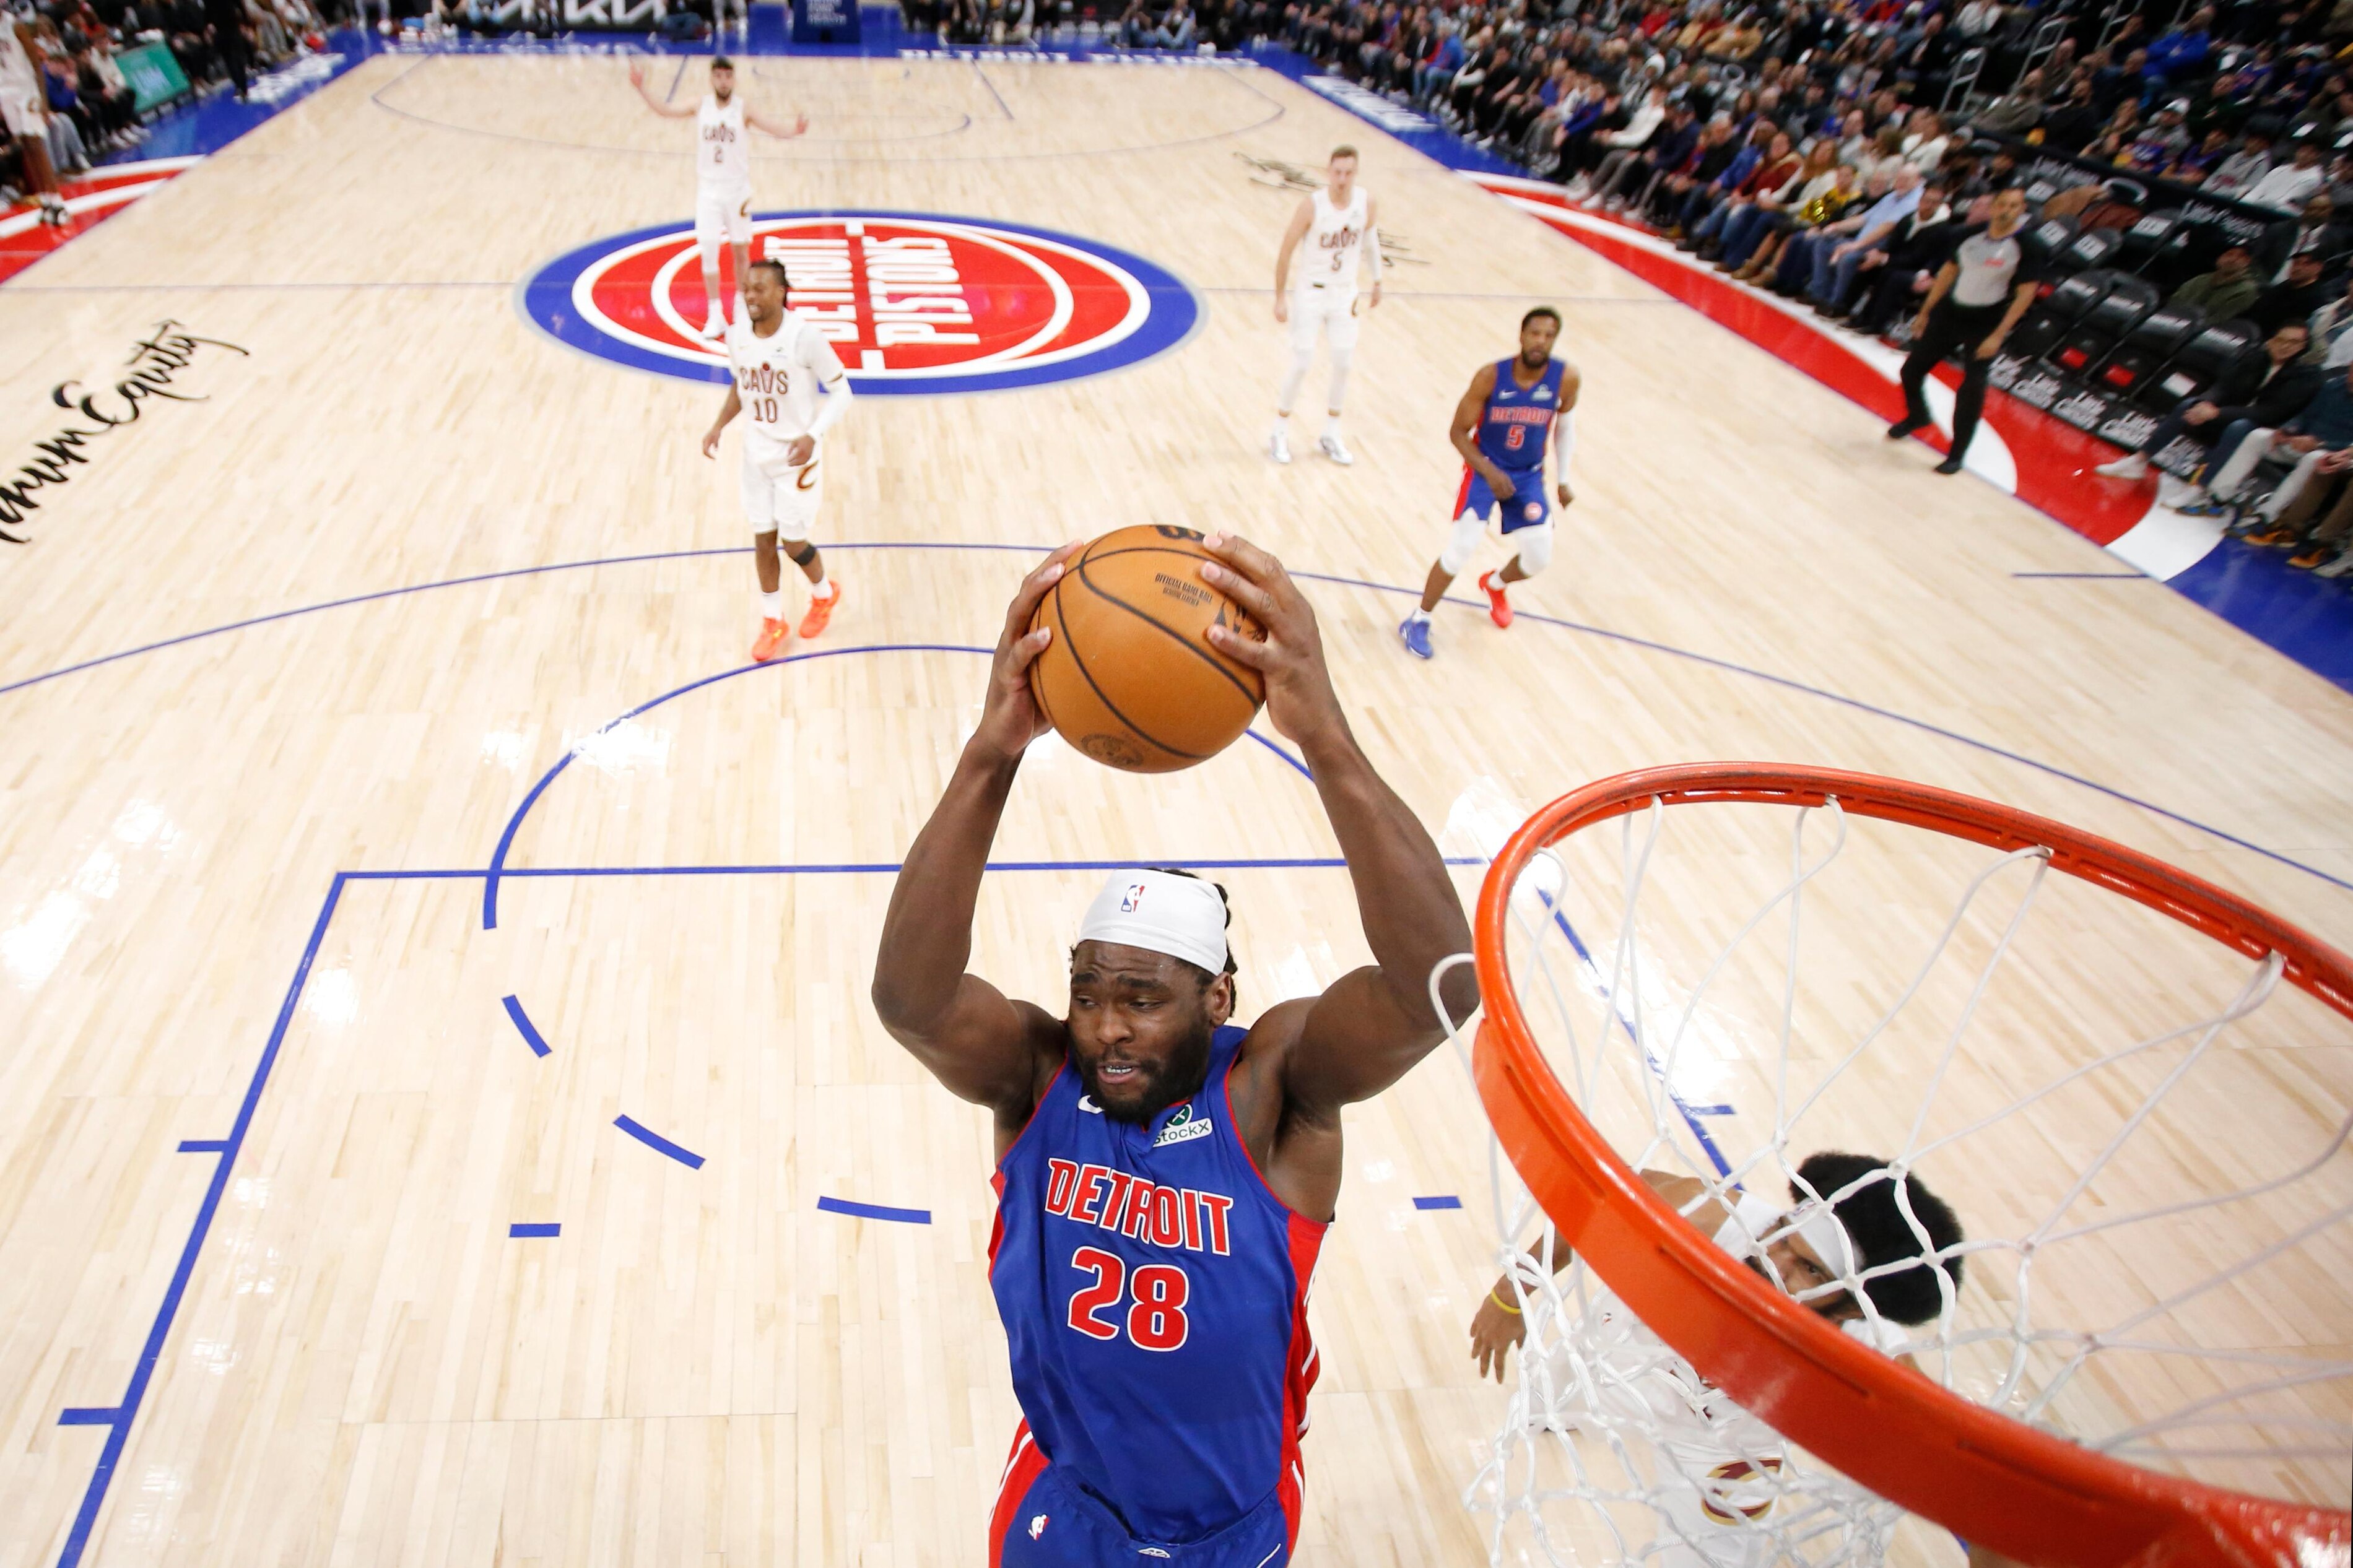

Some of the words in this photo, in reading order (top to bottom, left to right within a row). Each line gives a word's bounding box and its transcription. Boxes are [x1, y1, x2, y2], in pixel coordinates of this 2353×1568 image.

[861, 235, 981, 347] PISTONS
[739, 361, 788, 394] CAVS
[753, 397, 777, 423] 10
[1489, 406, 1553, 425] DETROIT
[1506, 425, 1526, 451] 5
[1155, 573, 1181, 589] OFFICIAL
[1181, 582, 1199, 596] GAME
[1045, 1158, 1234, 1256] DETROIT
[1068, 1245, 1190, 1353] 28
